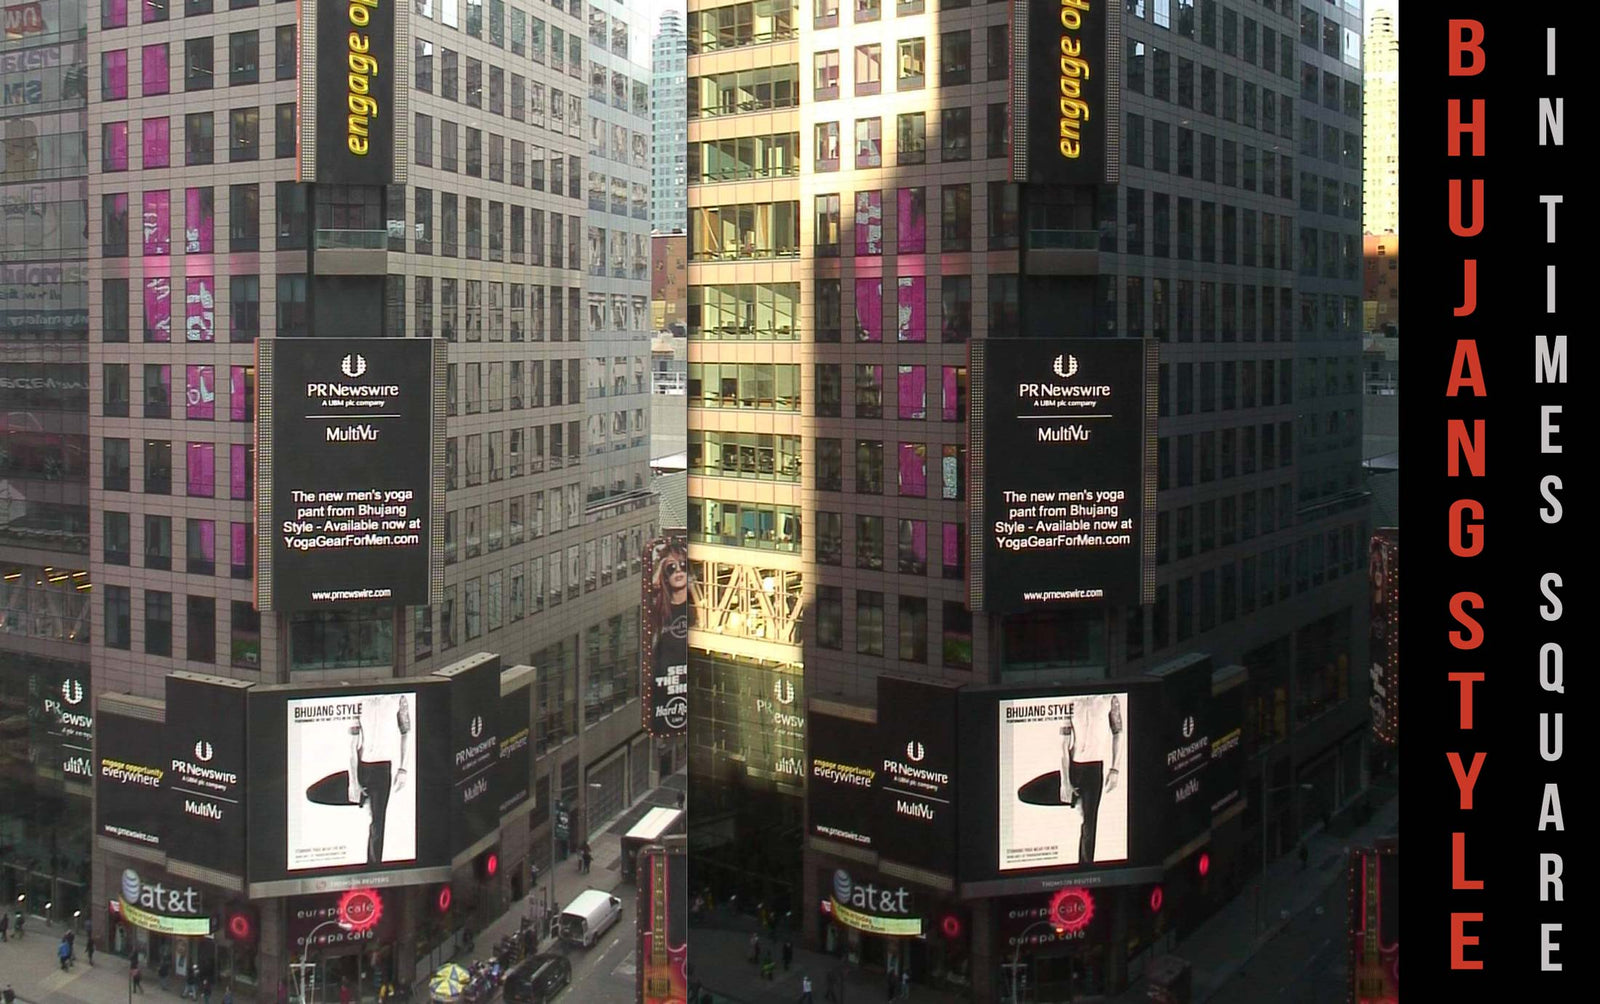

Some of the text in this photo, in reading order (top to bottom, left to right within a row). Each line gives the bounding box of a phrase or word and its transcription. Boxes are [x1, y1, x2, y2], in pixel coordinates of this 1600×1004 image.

[348, 32, 378, 156] engage
[1060, 36, 1090, 159] engage
[308, 384, 399, 396] PR Newswire
[1019, 384, 1111, 397] PR Newswire
[292, 490, 412, 502] The new men's yoga
[1003, 490, 1124, 503] The new men's yoga
[298, 504, 406, 519] pant from Bhujang
[1009, 504, 1118, 519] pant from Bhujang
[283, 521, 313, 535] Style
[324, 520, 378, 532] Available
[382, 522, 406, 530] now
[409, 518, 420, 529] at
[995, 521, 1025, 535] Style
[1035, 520, 1090, 532] Available
[1093, 522, 1118, 530] now
[1121, 519, 1132, 529] at
[284, 534, 419, 550] YogaGearForMen.com
[996, 534, 1131, 550] YogaGearForMen.com
[312, 588, 392, 601] www.prnewswire.com
[1024, 589, 1103, 601] www.prnewswire.com
[655, 675, 680, 687] THE
[294, 703, 362, 718] BHUJANG STYLE
[656, 703, 678, 717] Hard
[1006, 703, 1074, 718] BHUJANG STYLE
[102, 766, 160, 788] everywhere
[187, 763, 236, 784] Newswire
[814, 766, 872, 788] everywhere
[899, 763, 948, 784] Newswire
[140, 882, 198, 913] at&t
[852, 883, 909, 913] at&t
